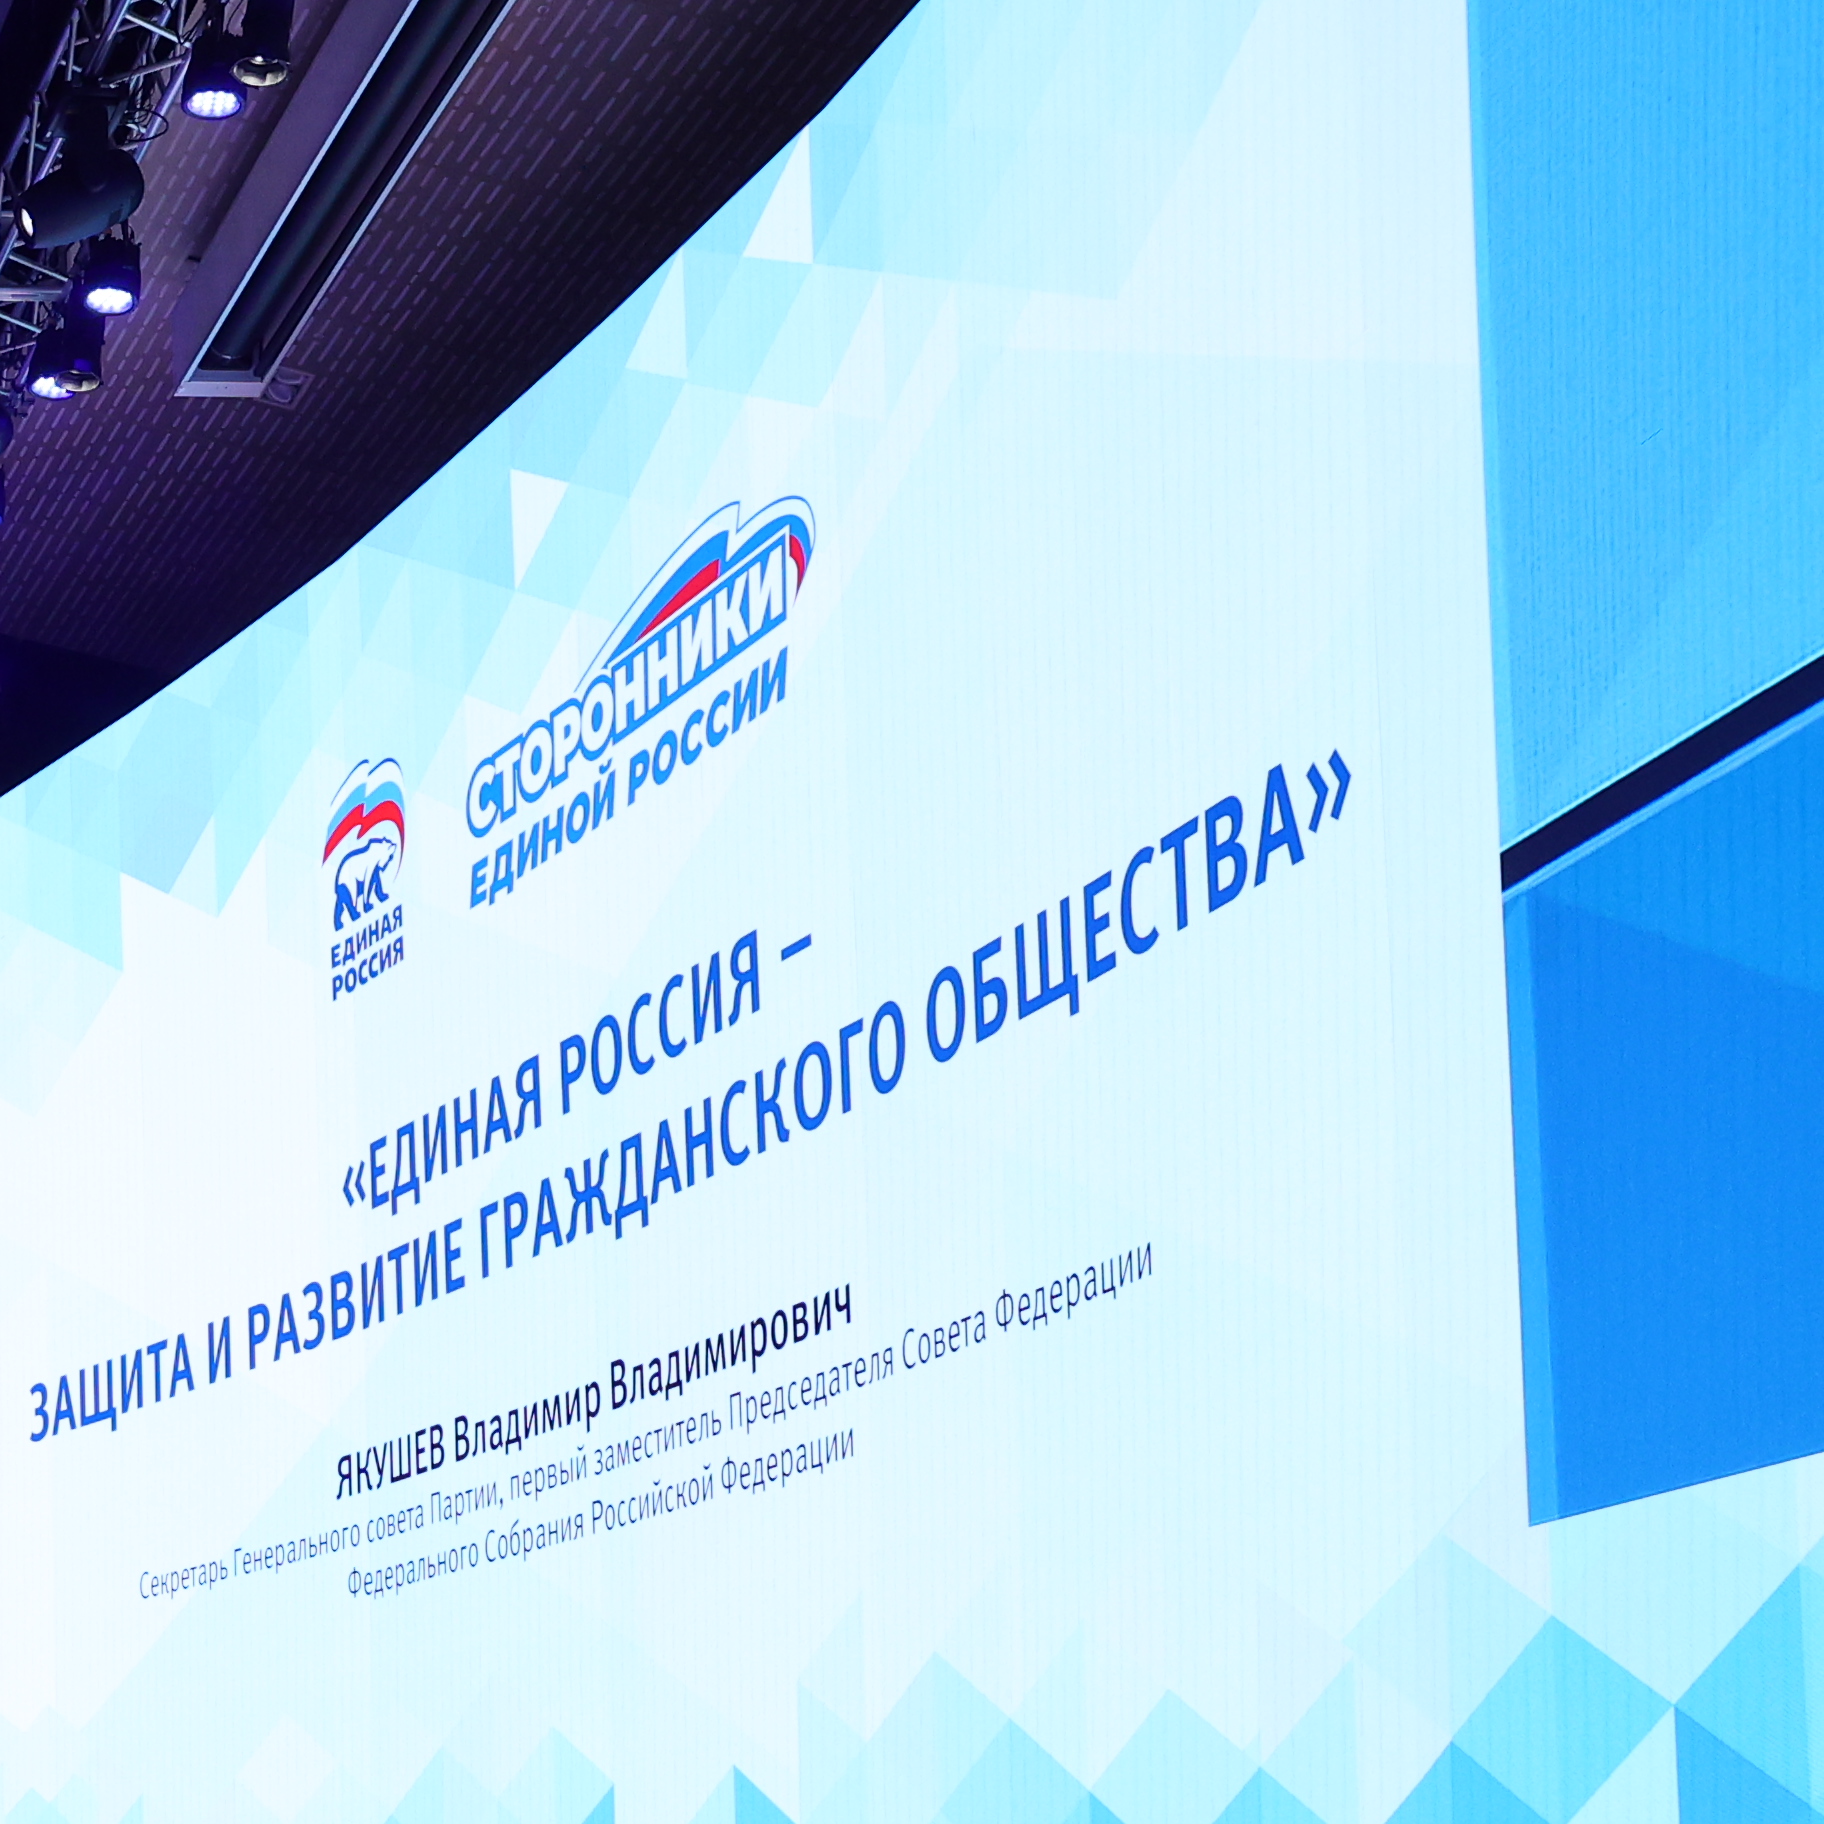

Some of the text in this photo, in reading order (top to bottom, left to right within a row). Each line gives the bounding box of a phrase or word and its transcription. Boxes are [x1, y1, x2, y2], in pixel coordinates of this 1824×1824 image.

[466, 529, 788, 838] СТОРОННИКИ
[470, 645, 789, 910] ЕДИНОЙ РОССИИ
[330, 903, 404, 969] ЕДИНАЯ
[331, 934, 405, 1002] РОССИЯ
[29, 748, 1352, 1444] ЗАЩИТА И РАЗВИТИЕ ГРАЖДАНСКОГО ОБЩЕСТВА»
[342, 1054, 543, 1216] «ЕДИНАЯ
[558, 929, 761, 1114] РОССИЯ
[138, 1240, 1154, 1601] Секретарь Генерального совета Партии, первый заместитель Председателя Совета Федерации
[336, 1282, 853, 1501] ЯКУШЕВ Владимир Владимирович
[347, 1426, 856, 1601] Федерального Собрания Российской Федерации
